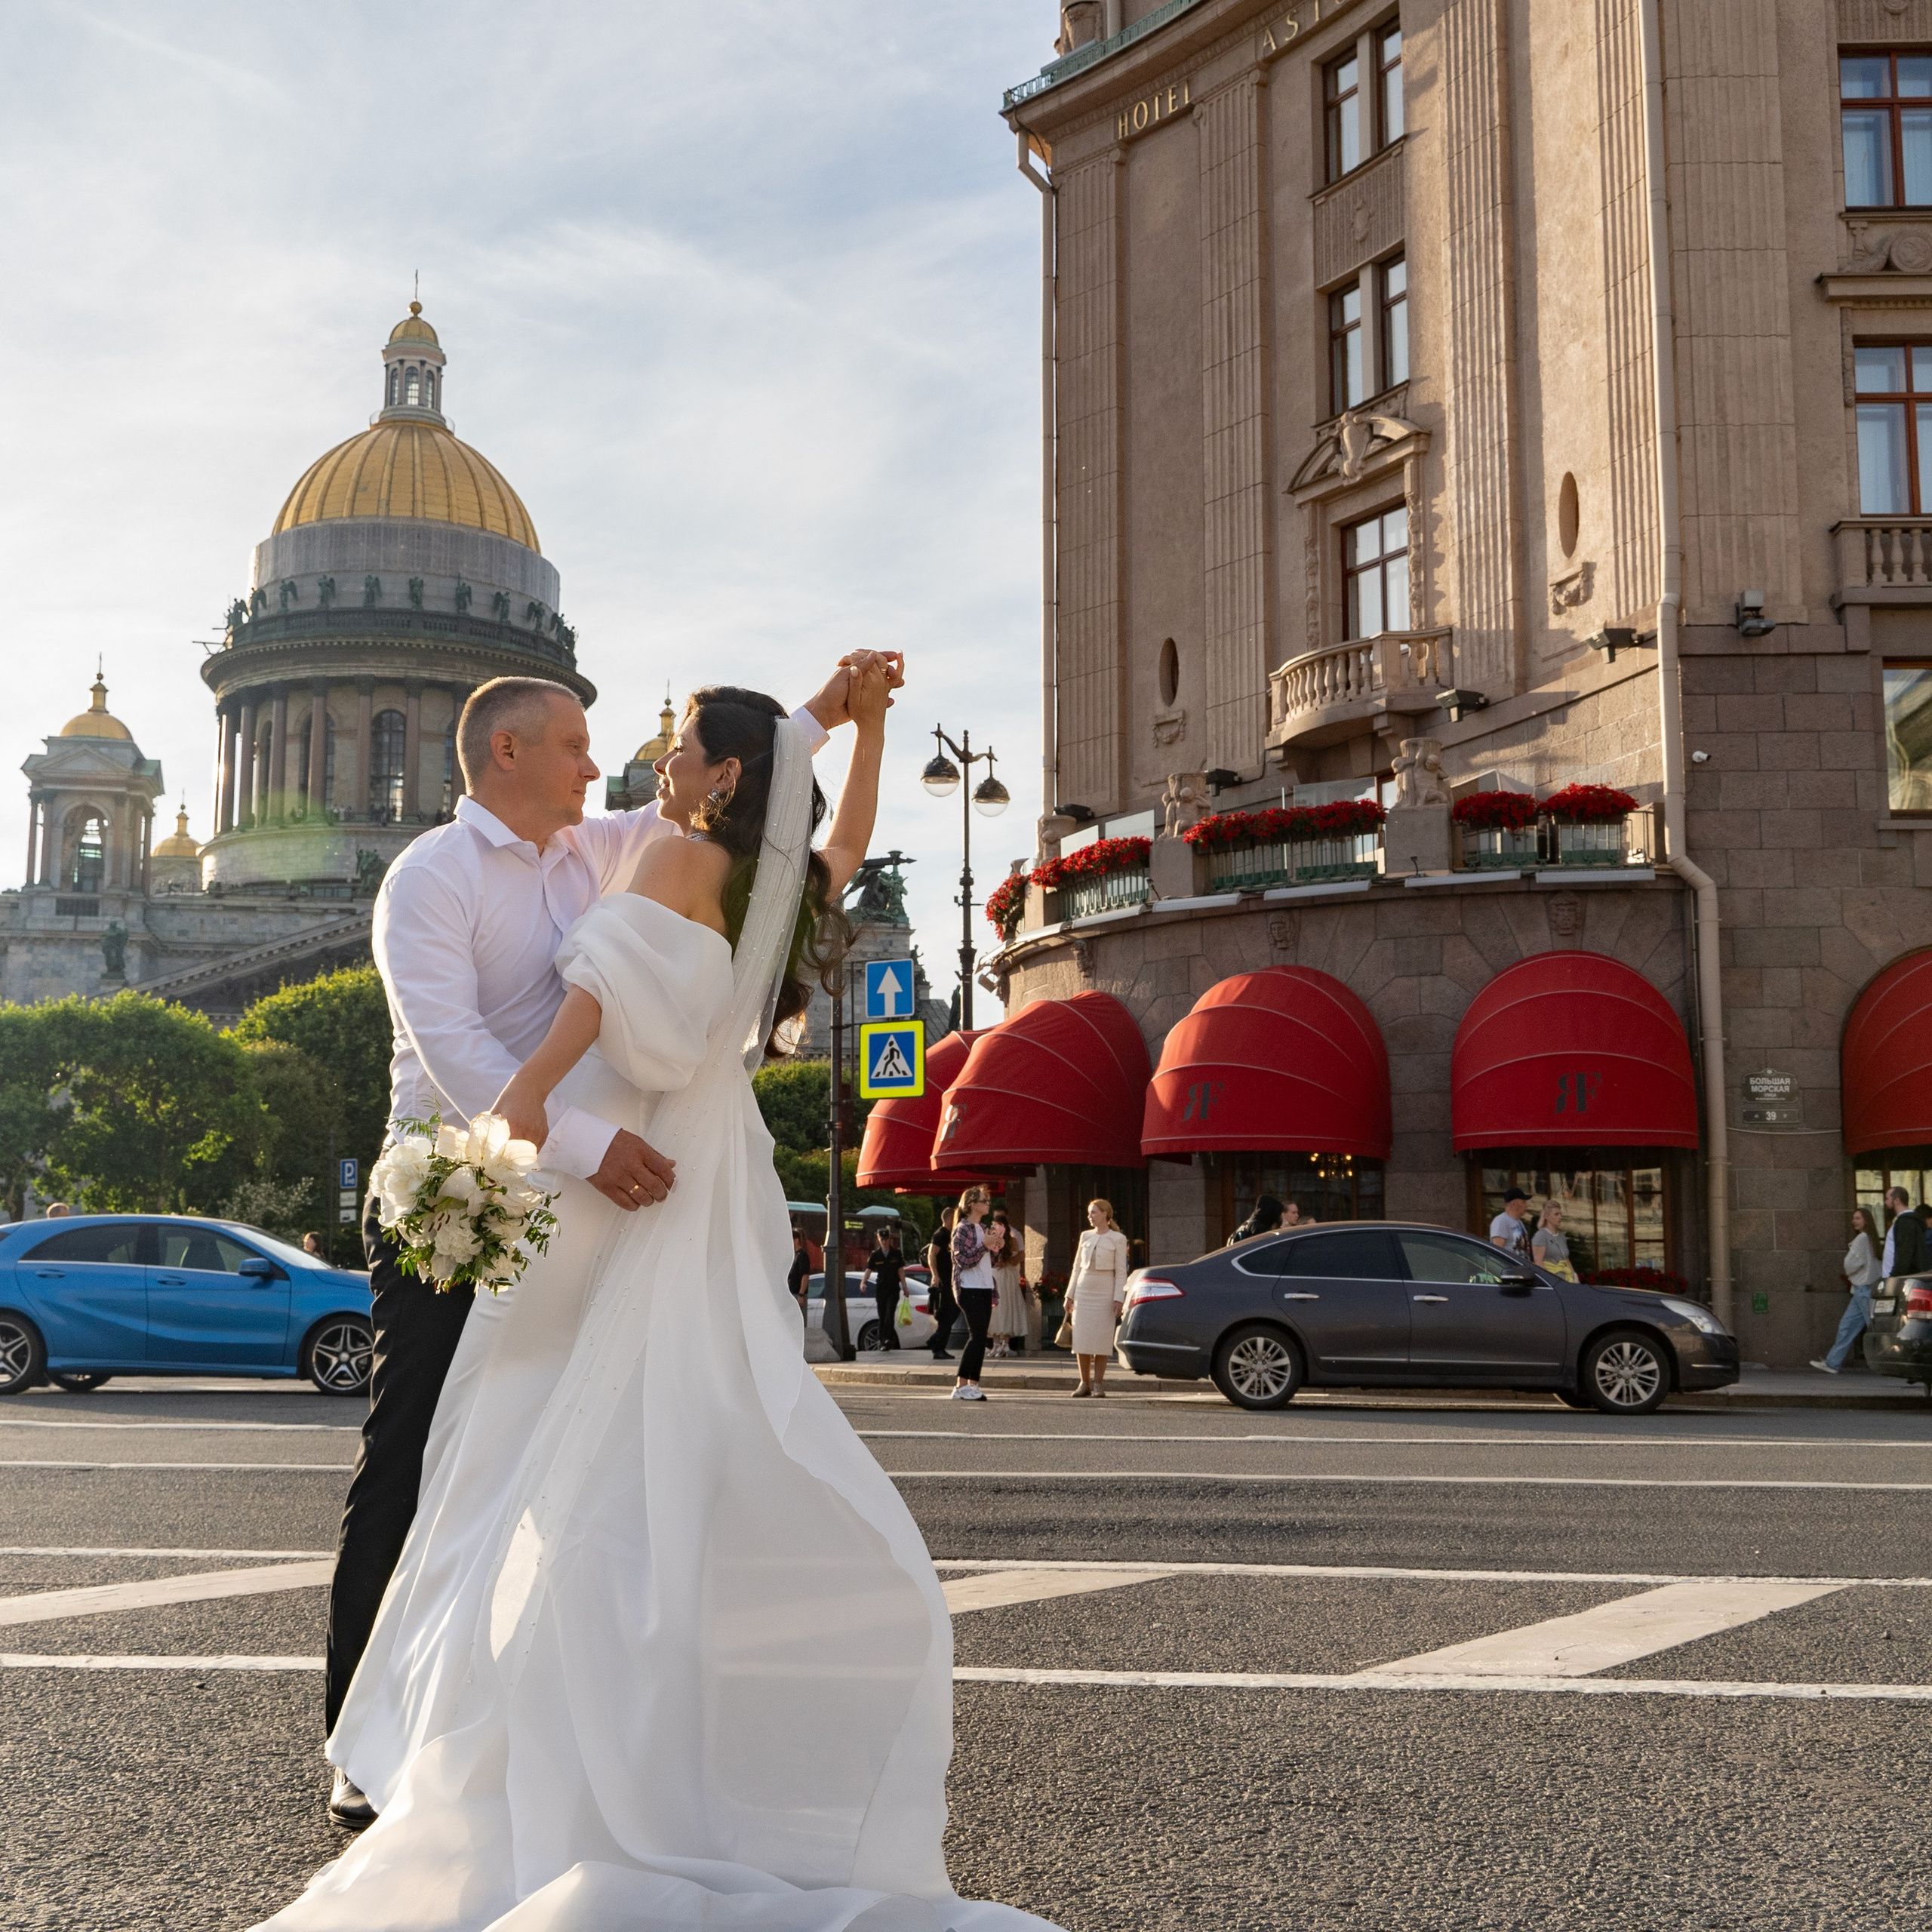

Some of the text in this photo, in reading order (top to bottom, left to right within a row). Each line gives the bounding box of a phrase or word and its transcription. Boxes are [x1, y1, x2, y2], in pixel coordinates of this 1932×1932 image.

[1118, 0, 1346, 140] HOTEL AST
[1749, 1077, 1791, 1085] БОЛЬШАЯ
[1765, 1111, 1777, 1121] 39
